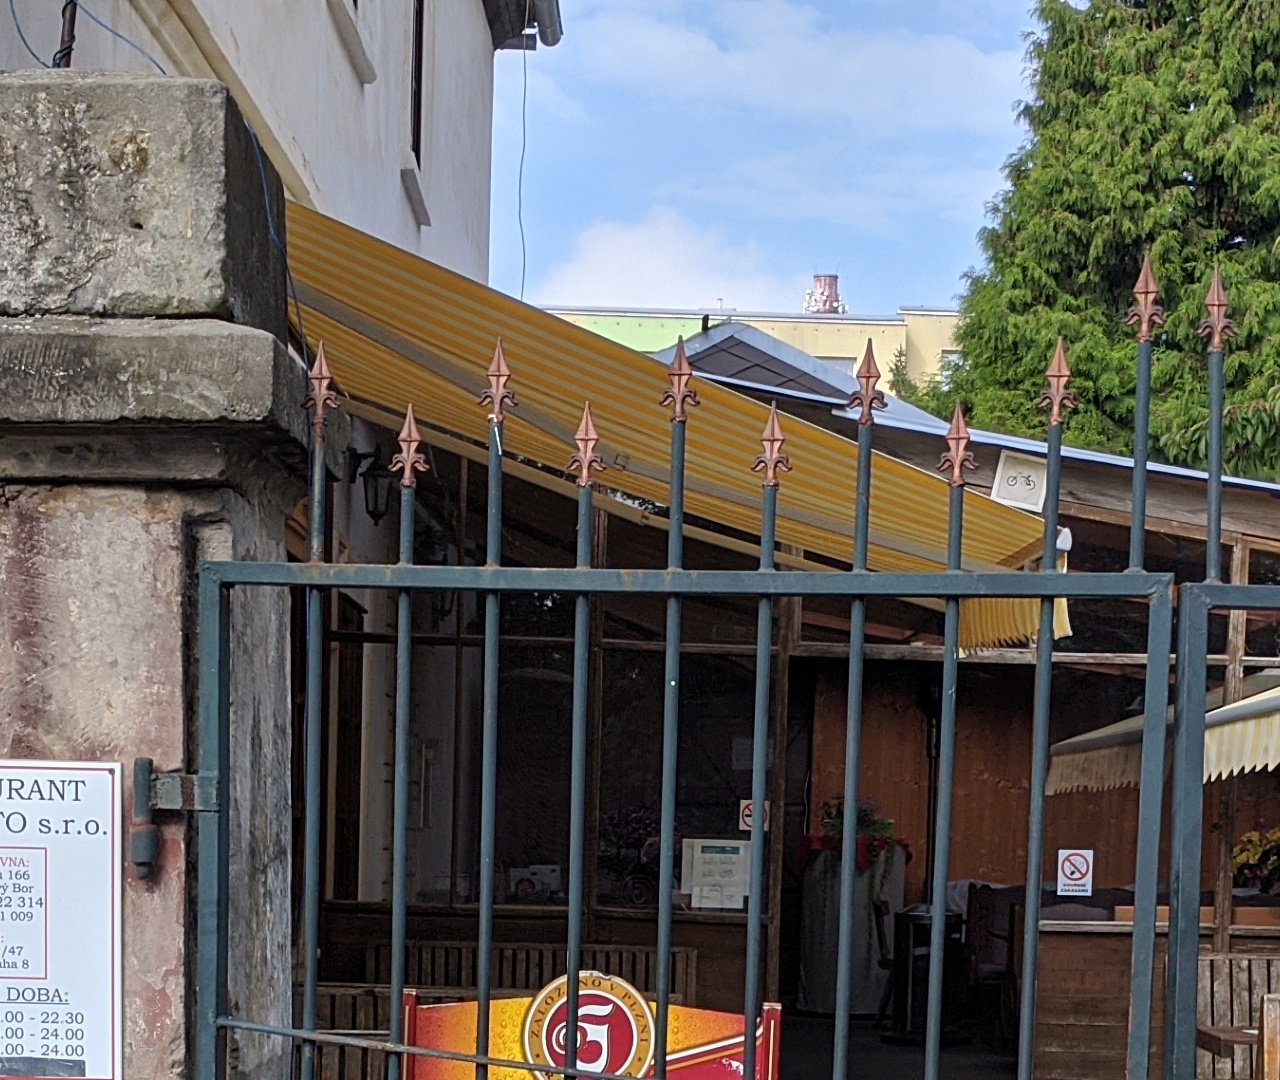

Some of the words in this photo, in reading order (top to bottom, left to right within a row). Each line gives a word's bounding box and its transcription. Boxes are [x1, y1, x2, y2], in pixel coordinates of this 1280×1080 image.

[38, 818, 107, 835] s.r.o.
[8, 870, 30, 880] 166
[12, 883, 34, 893] Bor
[17, 897, 44, 908] 314
[11, 911, 33, 922] 009
[21, 959, 29, 969] 8
[7, 988, 69, 1003] DOBA:
[40, 1012, 84, 1024] 22.30
[40, 1029, 84, 1041] 24.00
[40, 1045, 84, 1057] 24.00
